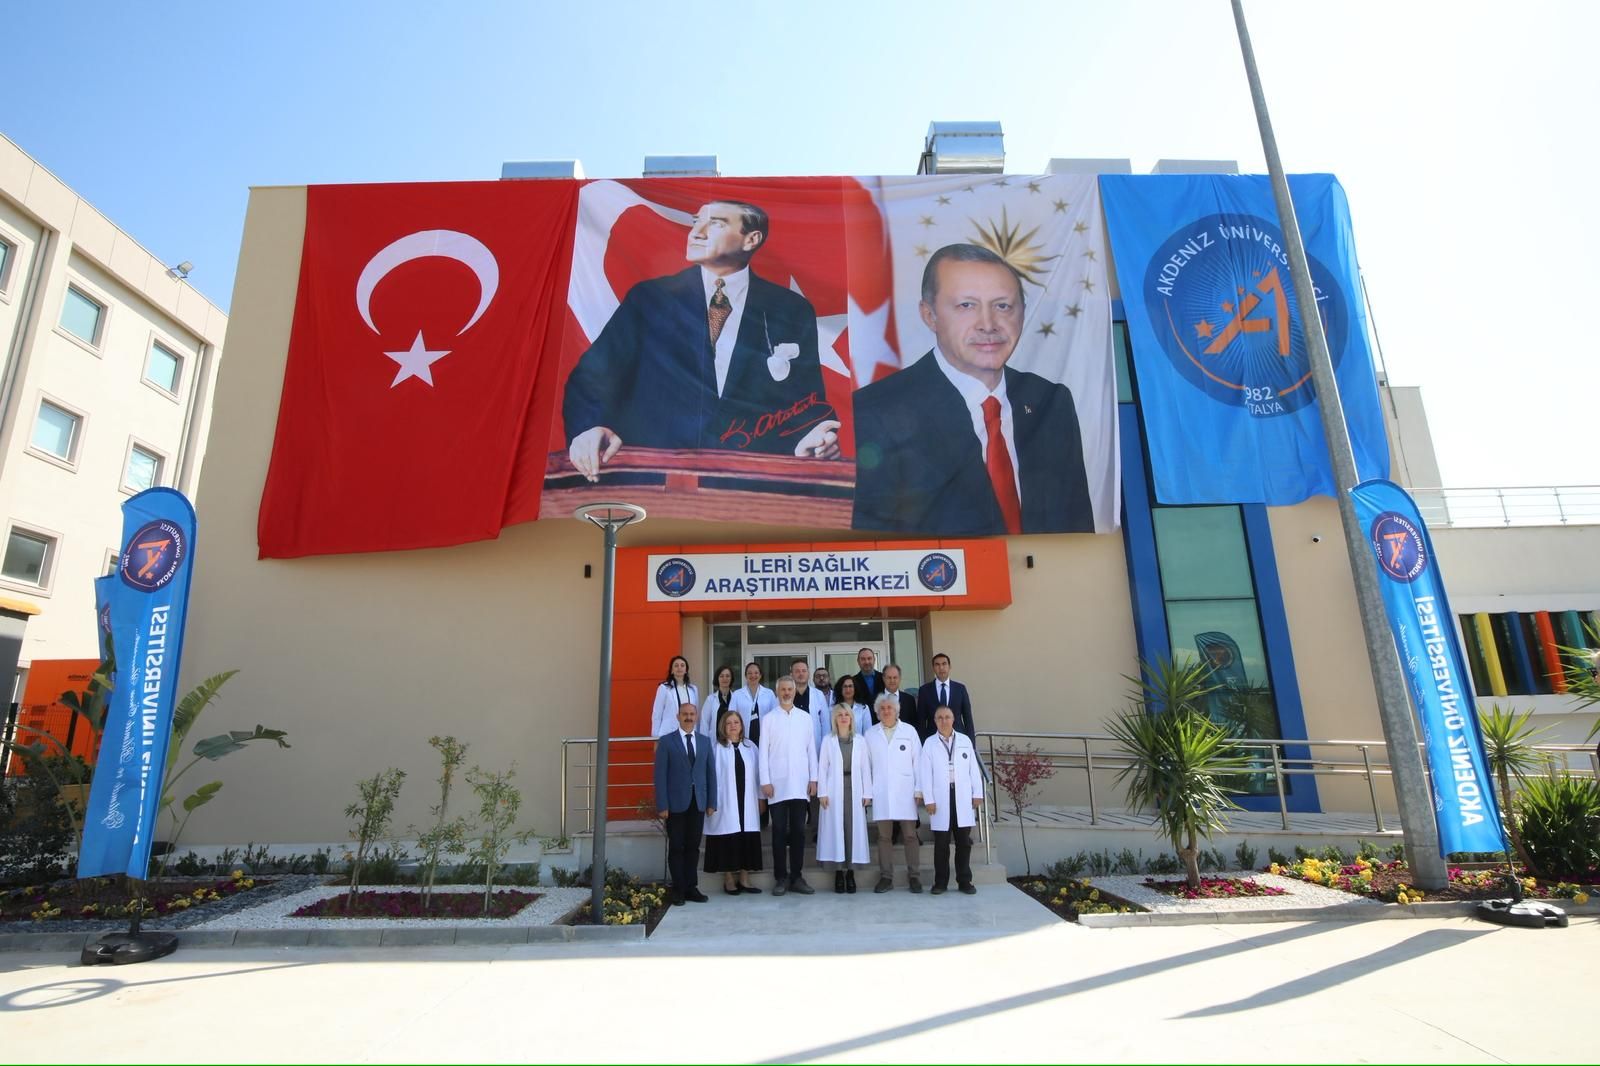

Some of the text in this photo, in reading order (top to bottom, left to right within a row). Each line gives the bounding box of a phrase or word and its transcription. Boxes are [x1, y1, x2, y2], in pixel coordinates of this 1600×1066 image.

[1157, 231, 1215, 297] AKDENİZ
[744, 554, 870, 574] İLERİ SAĞLIK
[704, 571, 910, 596] ARAŞTIRMA MERKEZİ
